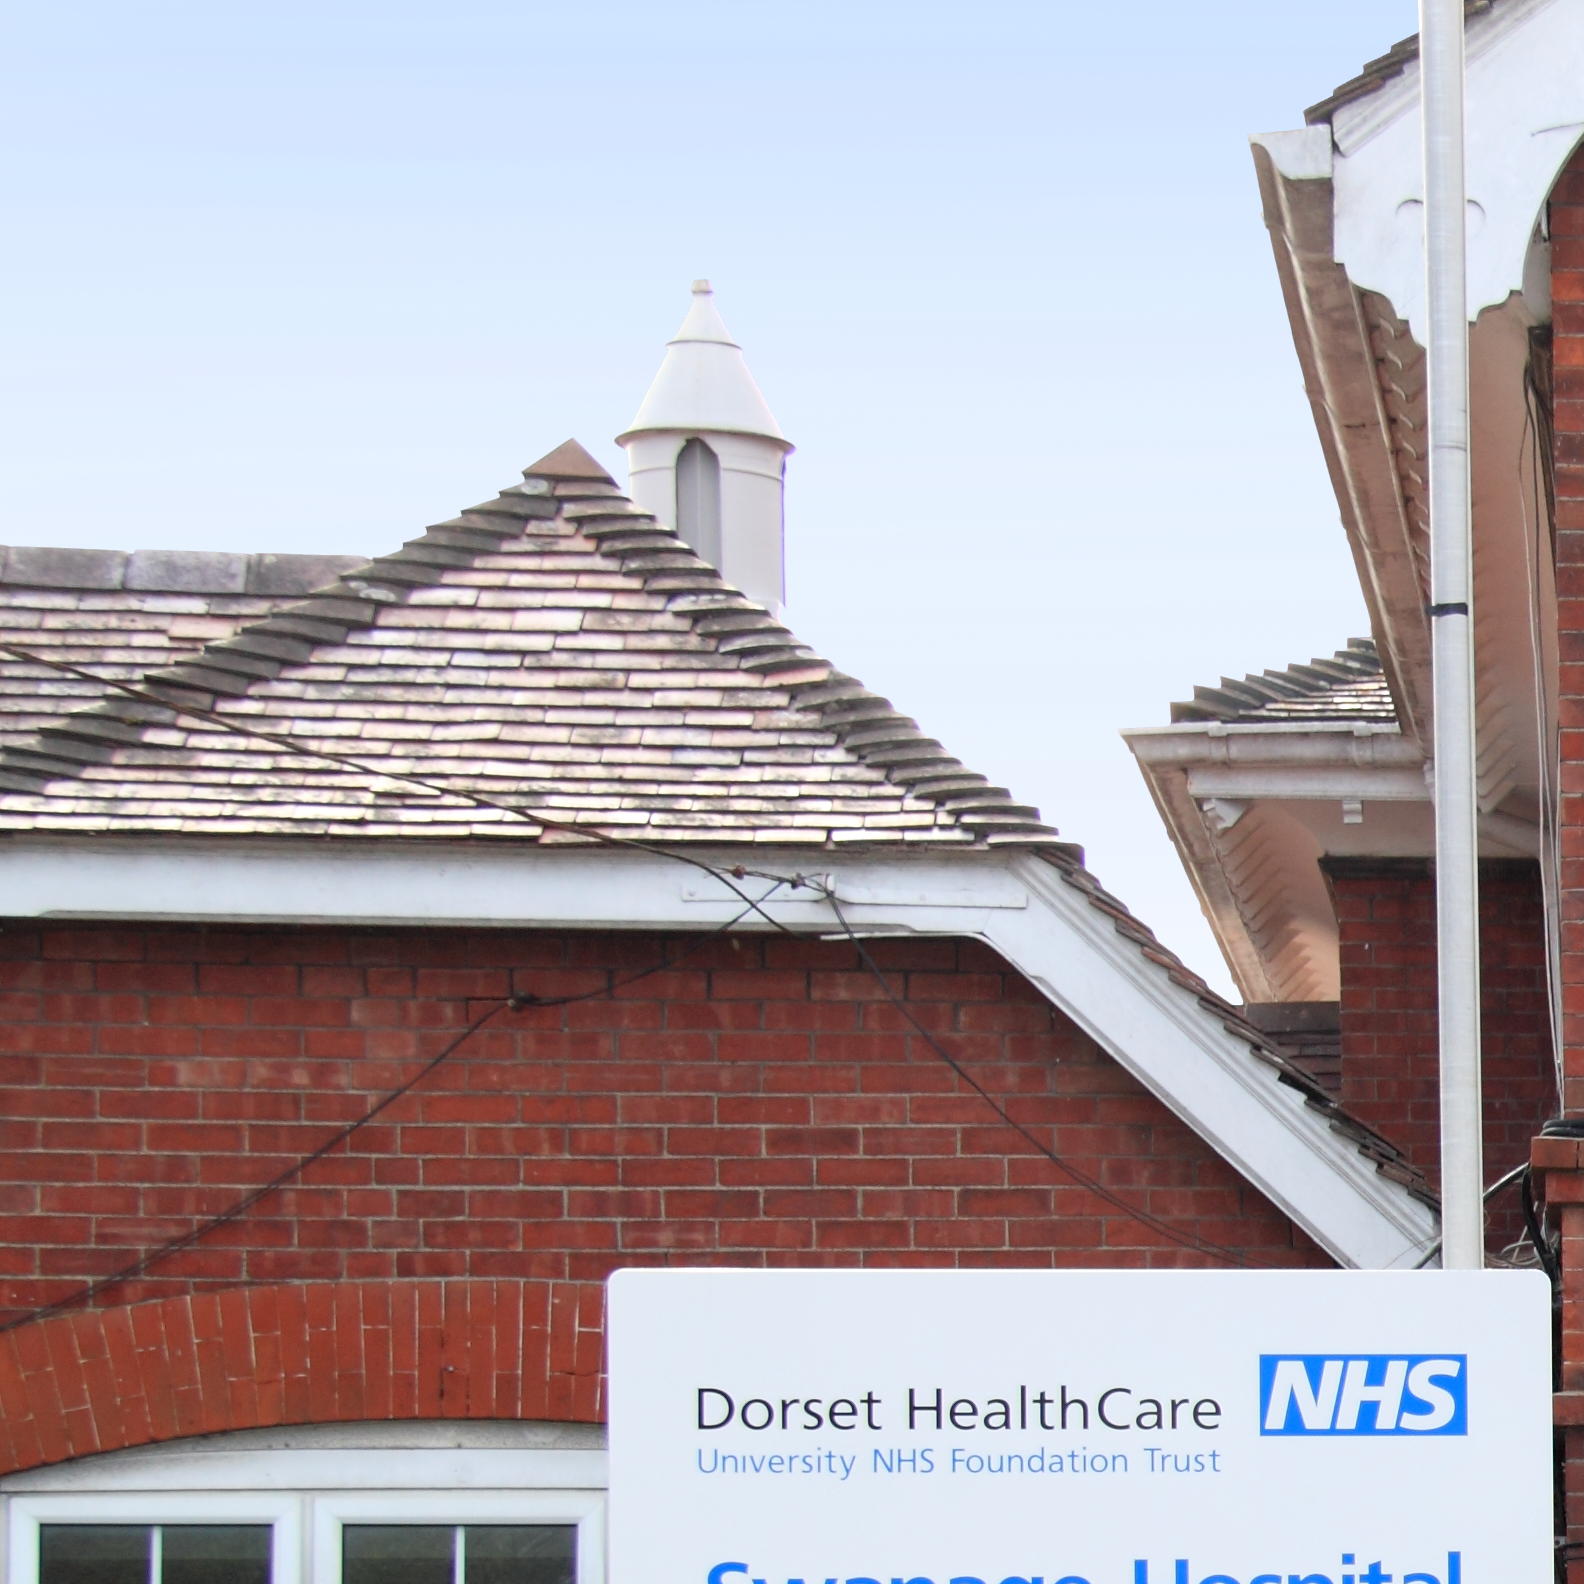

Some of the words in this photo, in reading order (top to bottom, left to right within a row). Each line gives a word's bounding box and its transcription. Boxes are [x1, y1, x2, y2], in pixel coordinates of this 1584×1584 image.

[696, 1387, 882, 1432] Dorset
[908, 1385, 1223, 1431] HealthCare
[1266, 1359, 1461, 1432] NHS
[698, 1447, 857, 1480] University
[872, 1449, 935, 1474] NHS
[951, 1446, 1128, 1474] Foundation
[1144, 1448, 1222, 1474] Trust
